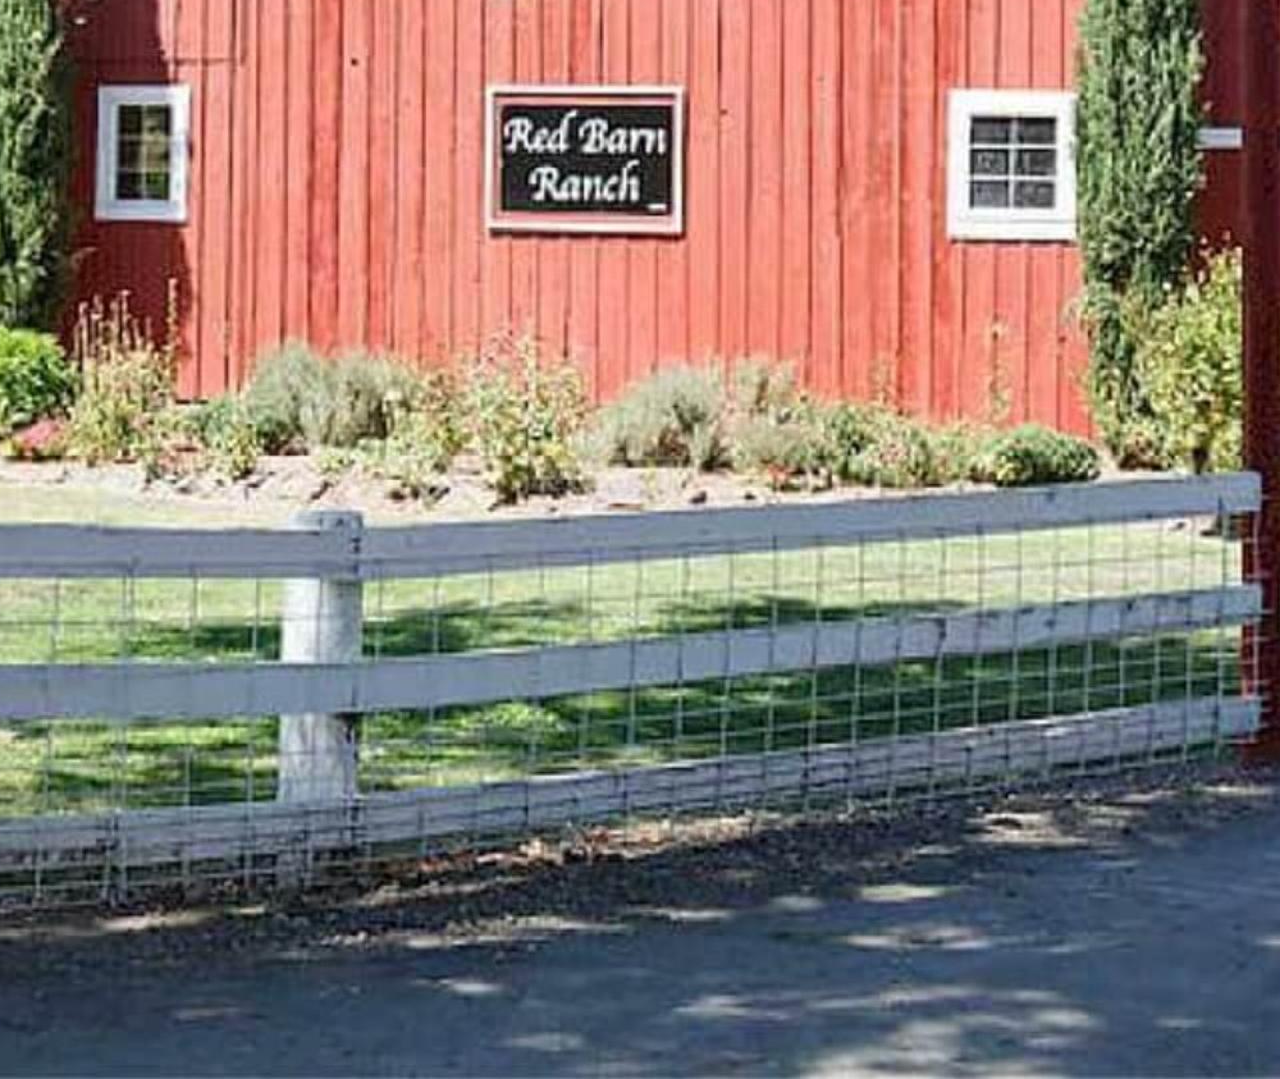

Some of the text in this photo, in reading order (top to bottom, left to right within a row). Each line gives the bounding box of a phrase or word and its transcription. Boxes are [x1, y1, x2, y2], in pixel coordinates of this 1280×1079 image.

[503, 109, 667, 156] Red Barn
[527, 159, 640, 202] Ranch
